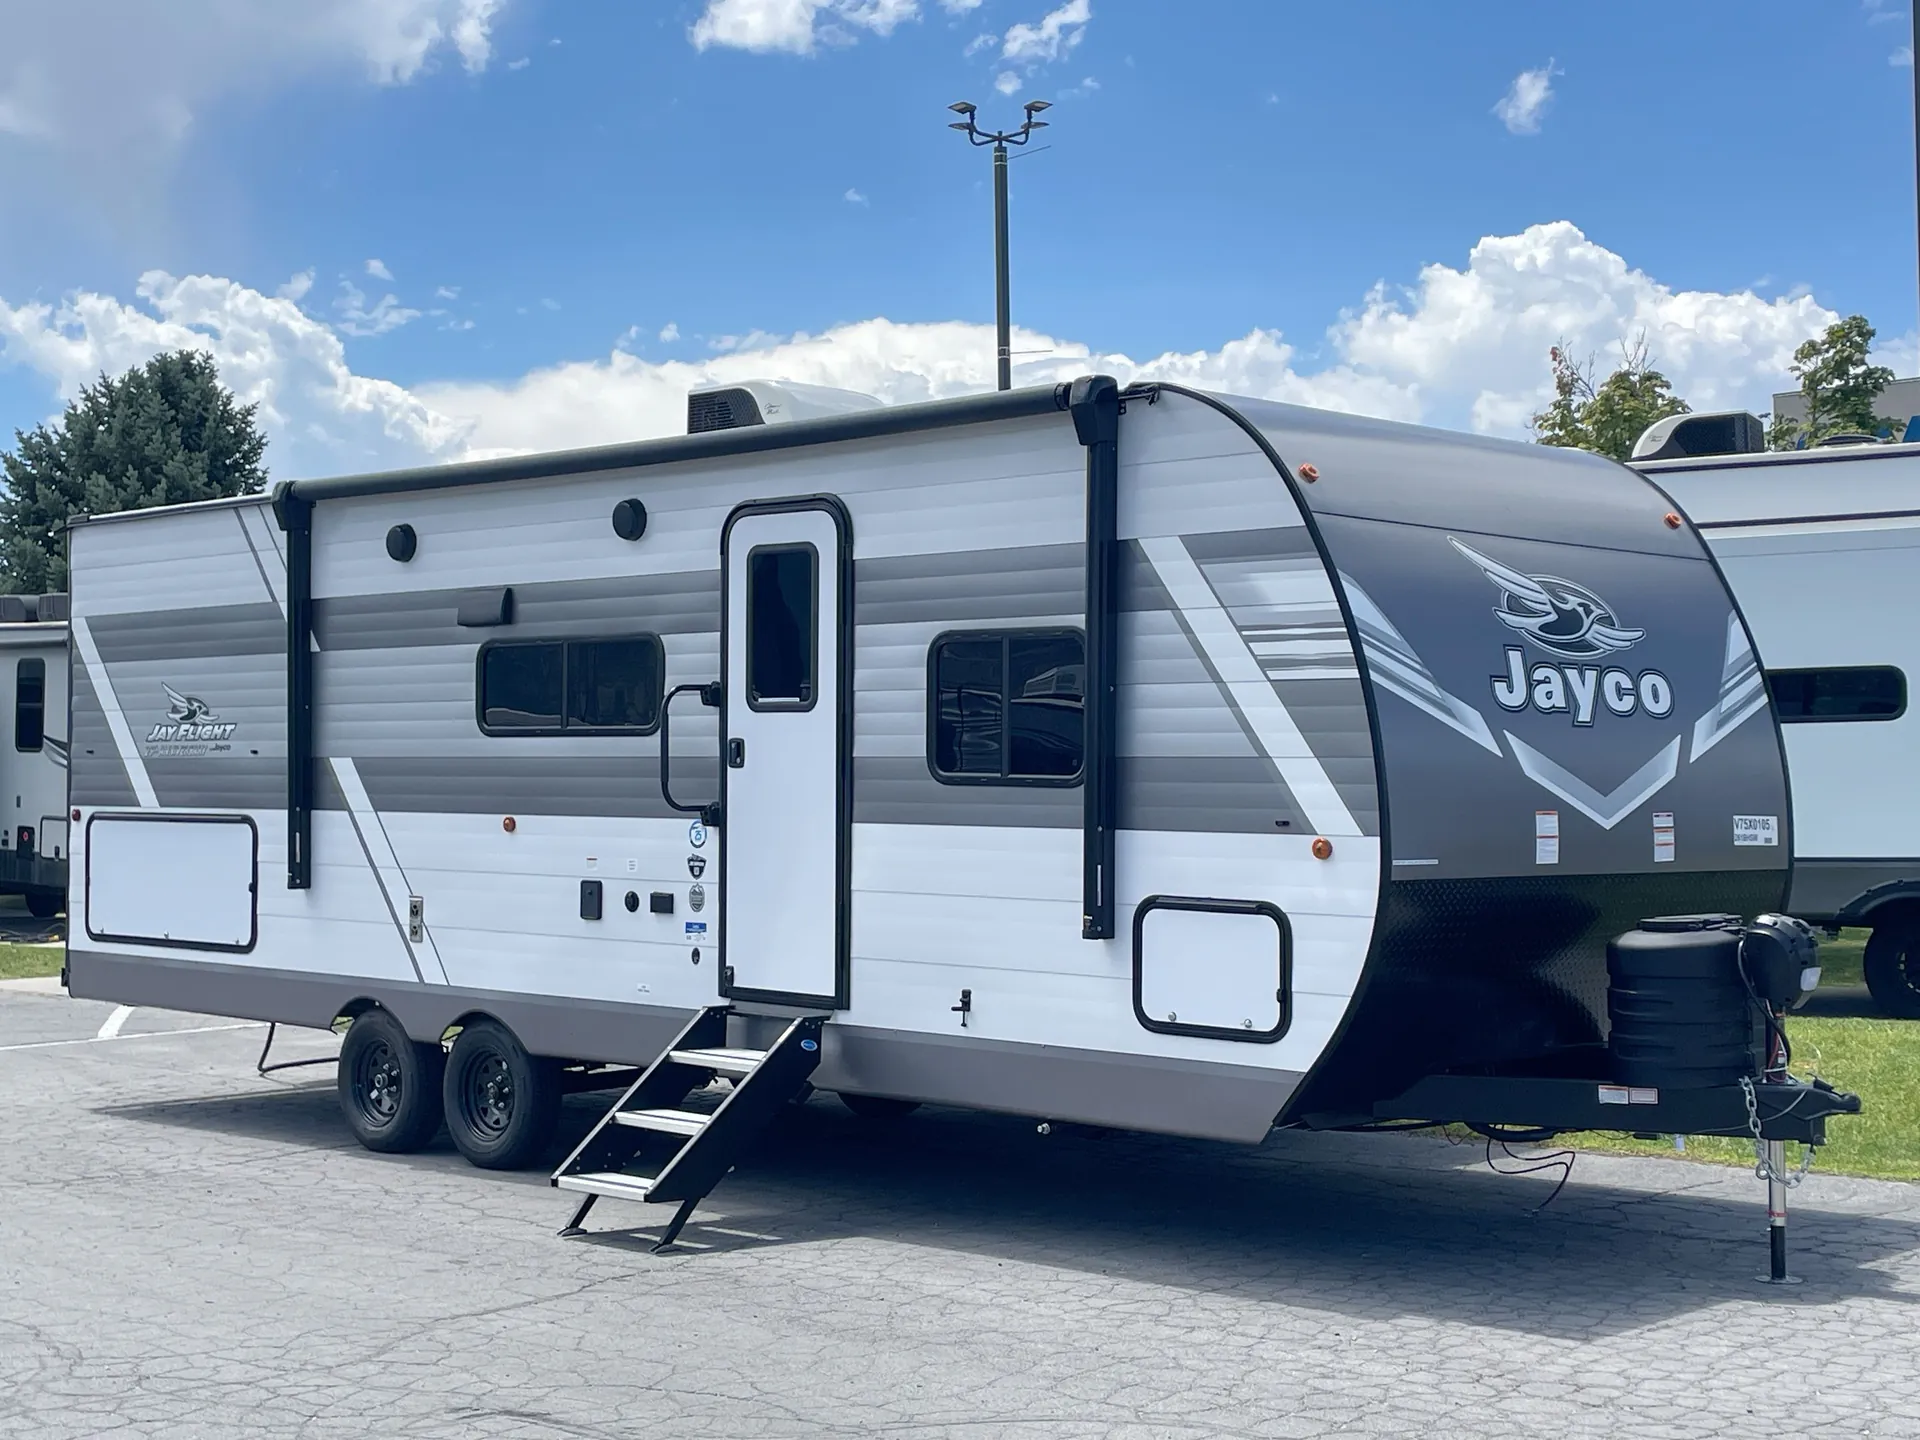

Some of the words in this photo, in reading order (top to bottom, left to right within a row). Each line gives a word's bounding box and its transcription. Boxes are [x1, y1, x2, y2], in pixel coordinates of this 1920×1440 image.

[1490, 644, 1675, 728] Jayco
[147, 724, 177, 742] JAY
[176, 723, 237, 742] FLIGHT
